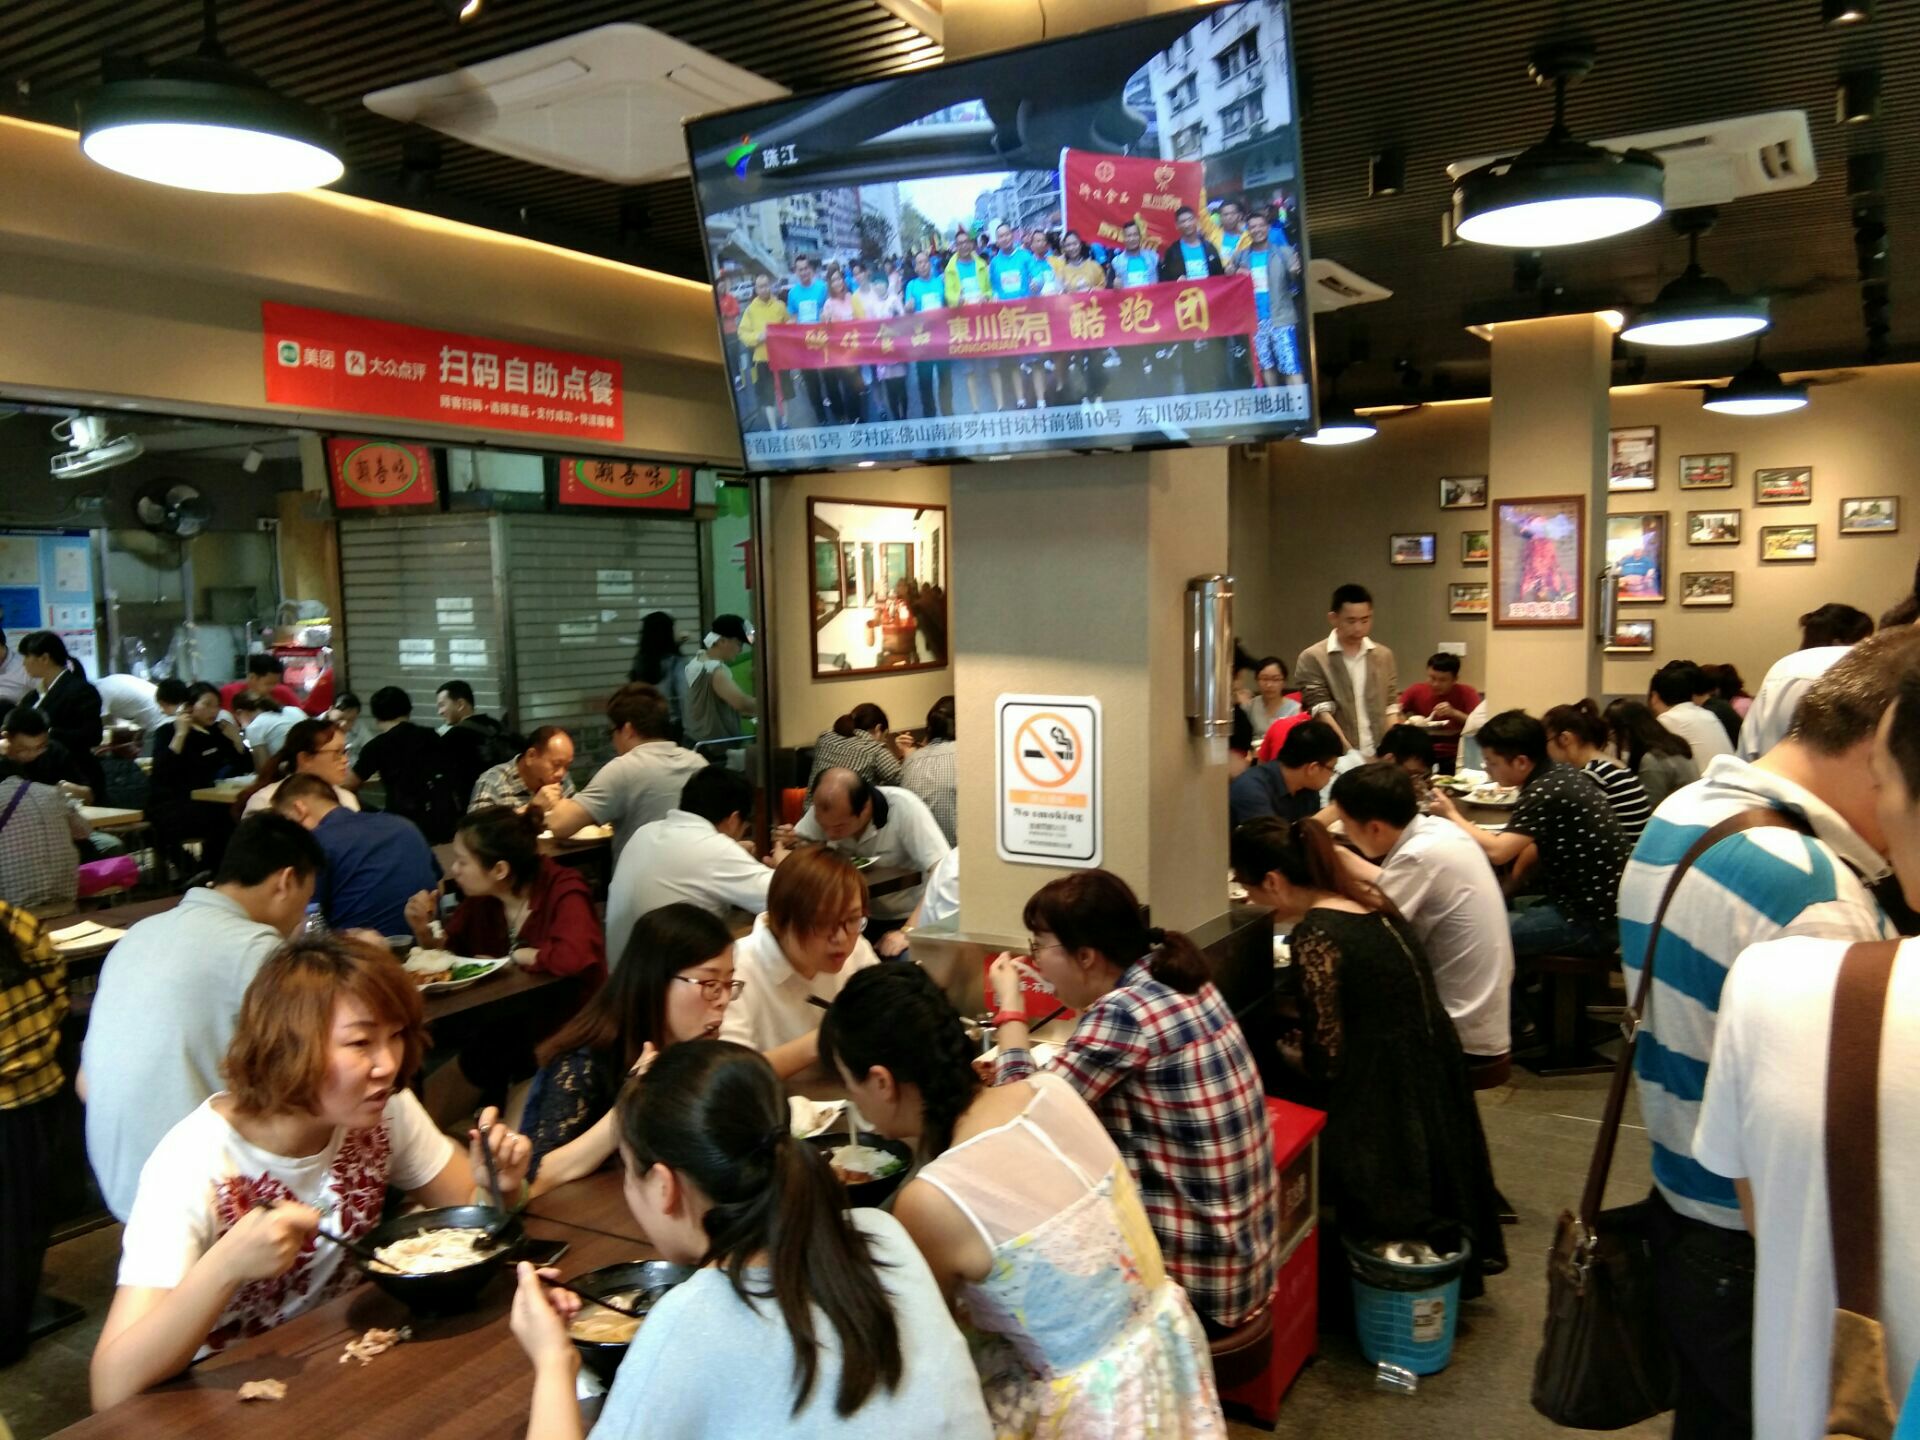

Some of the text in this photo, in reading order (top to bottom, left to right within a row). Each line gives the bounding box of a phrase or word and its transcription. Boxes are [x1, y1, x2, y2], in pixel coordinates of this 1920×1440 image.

[762, 144, 799, 169] 珠江
[1069, 286, 1211, 341] 酷跑团
[303, 348, 336, 370] 美团
[368, 356, 428, 383] 大众点评
[438, 344, 615, 407] 扫码自助点餐
[1031, 810, 1084, 823] smoking
